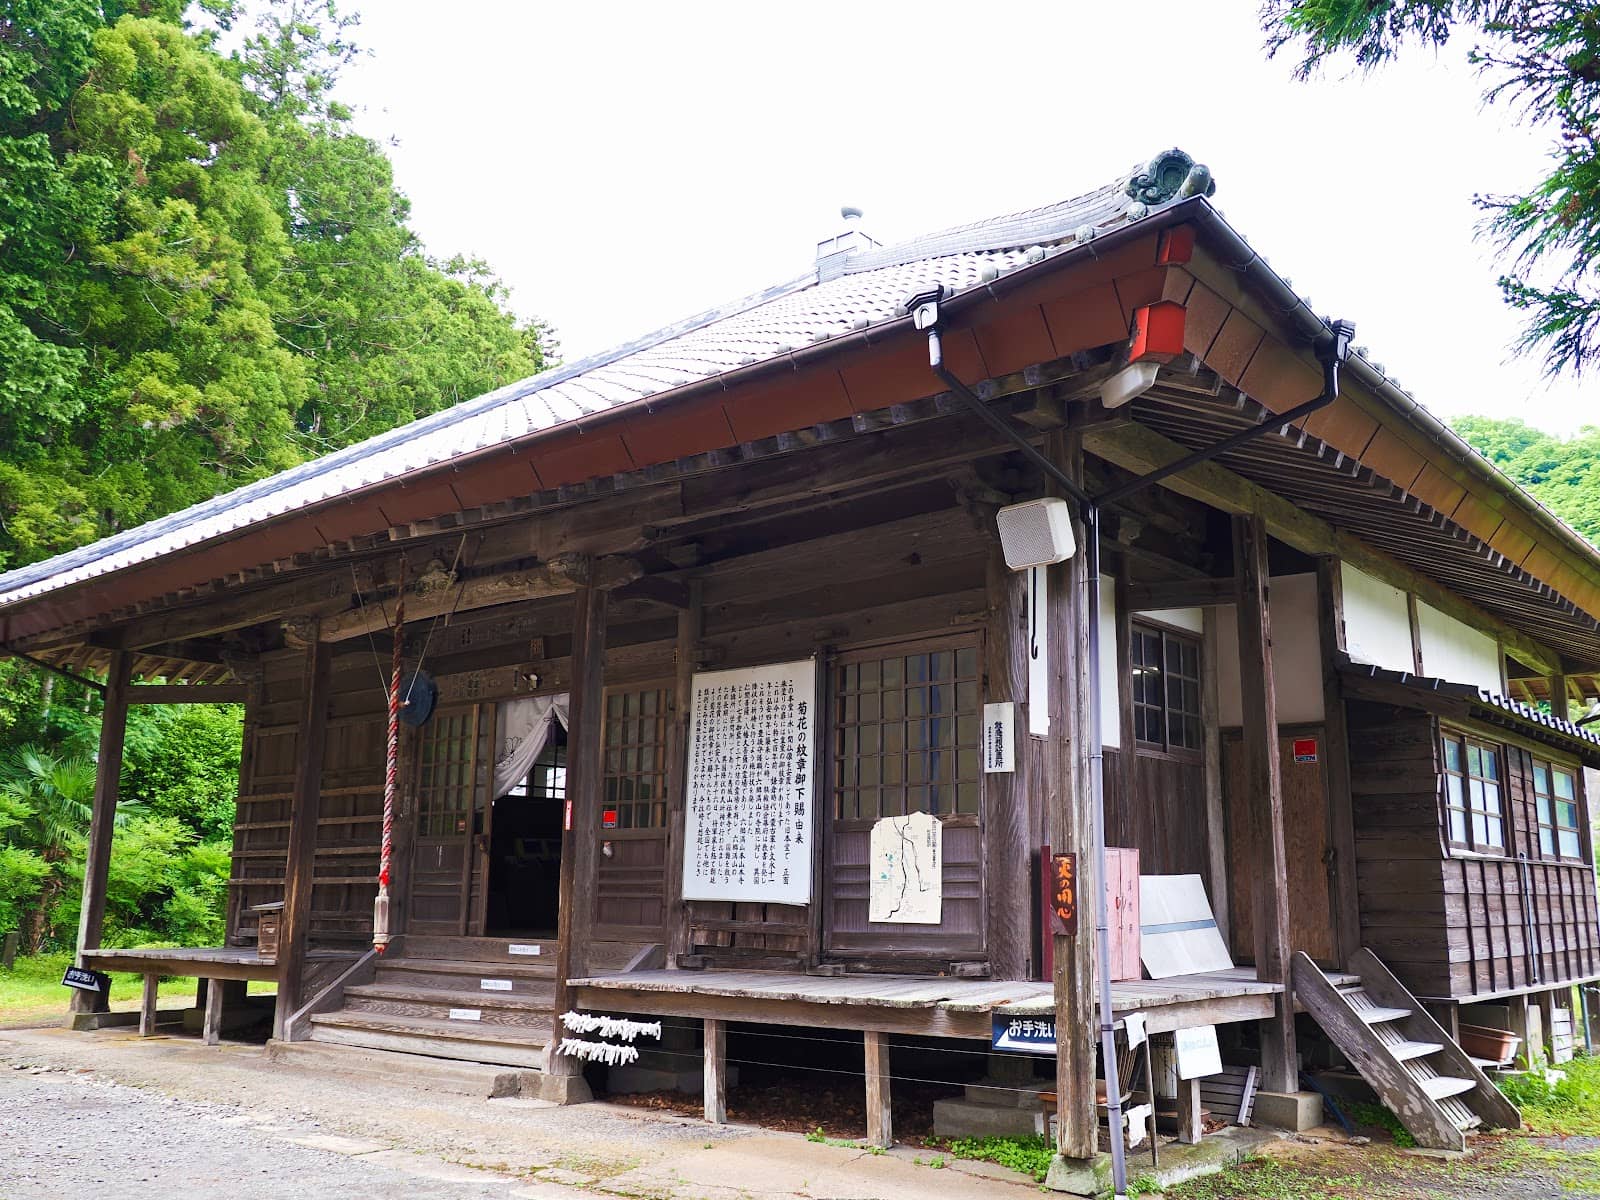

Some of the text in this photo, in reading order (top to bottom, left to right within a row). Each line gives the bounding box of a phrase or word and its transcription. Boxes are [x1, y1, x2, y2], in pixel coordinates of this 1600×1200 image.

[67, 970, 95, 983] お手洗い
[1008, 1018, 1057, 1039] お手洗い
